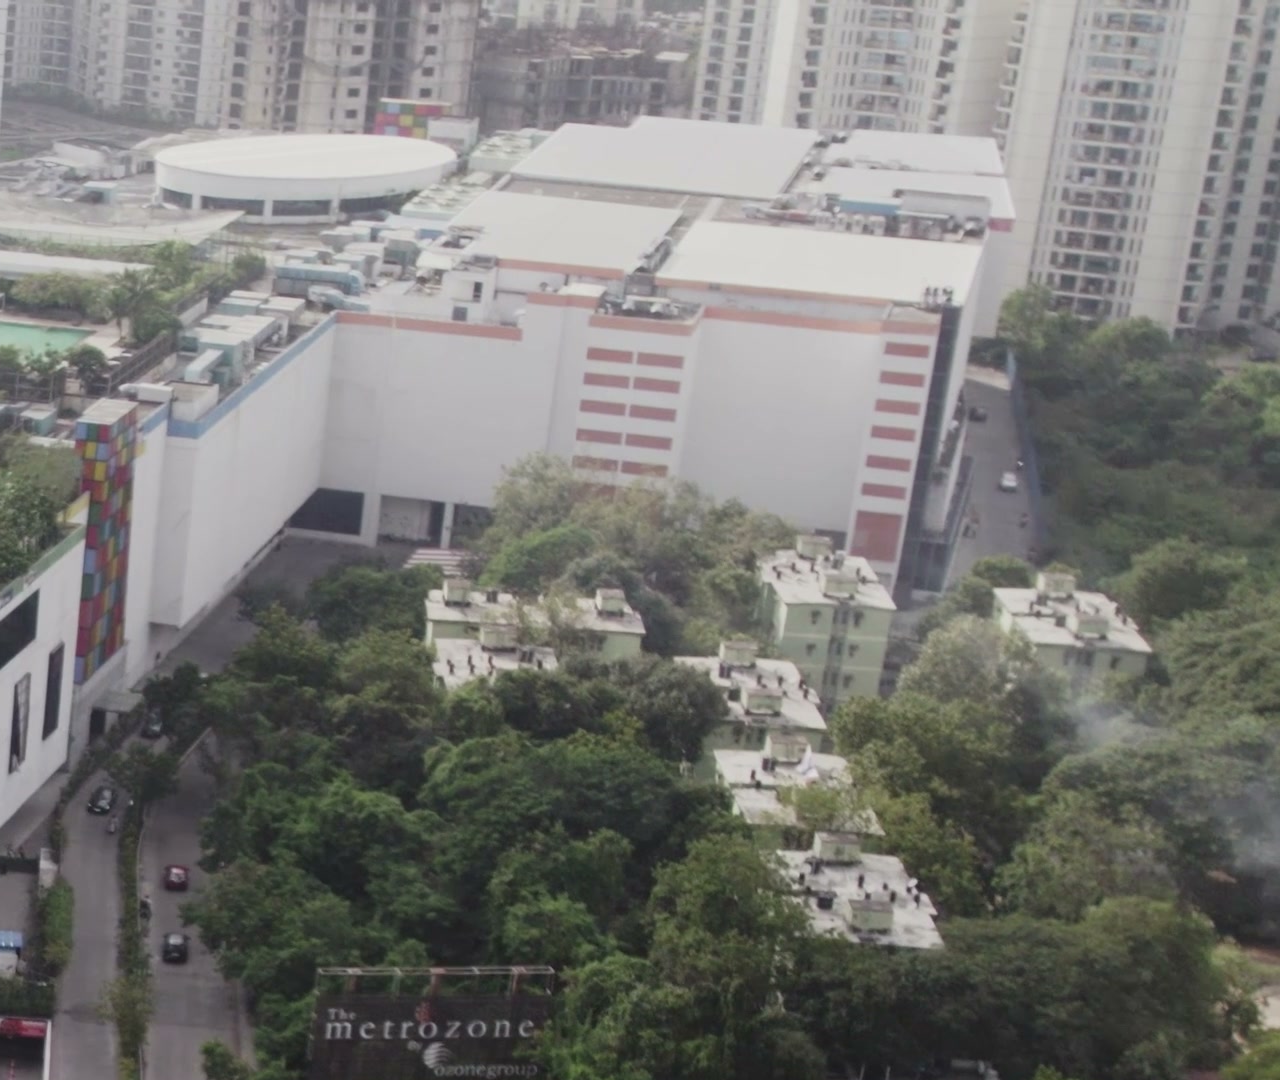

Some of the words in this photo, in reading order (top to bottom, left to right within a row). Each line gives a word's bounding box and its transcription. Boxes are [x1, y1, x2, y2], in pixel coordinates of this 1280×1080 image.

[328, 1008, 356, 1020] The
[325, 1019, 535, 1040] metrozone
[434, 1063, 538, 1079] ozonegroup
